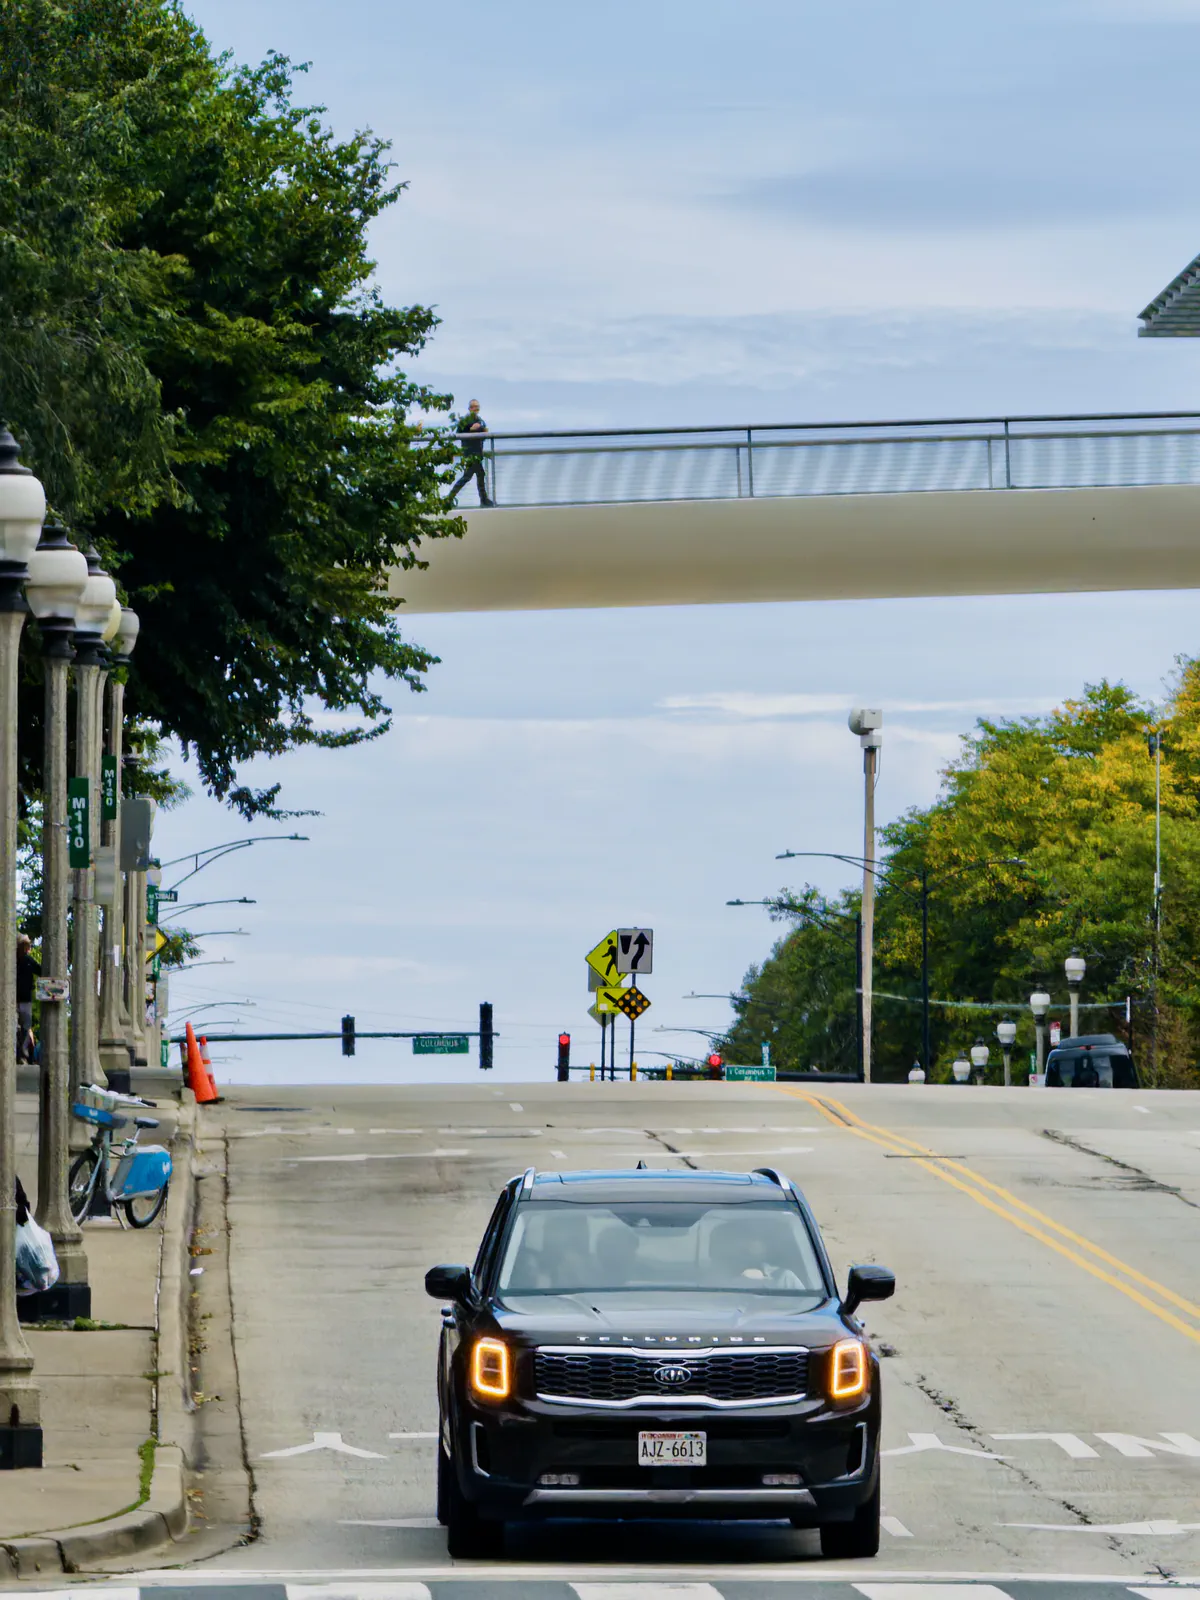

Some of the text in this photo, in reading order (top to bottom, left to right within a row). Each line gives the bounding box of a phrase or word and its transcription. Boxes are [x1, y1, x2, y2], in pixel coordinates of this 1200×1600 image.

[72, 797, 86, 848] M110
[576, 1335, 766, 1343] TELLURIDE
[659, 1369, 686, 1381] KIA
[641, 1440, 704, 1458] AJZ-6613
